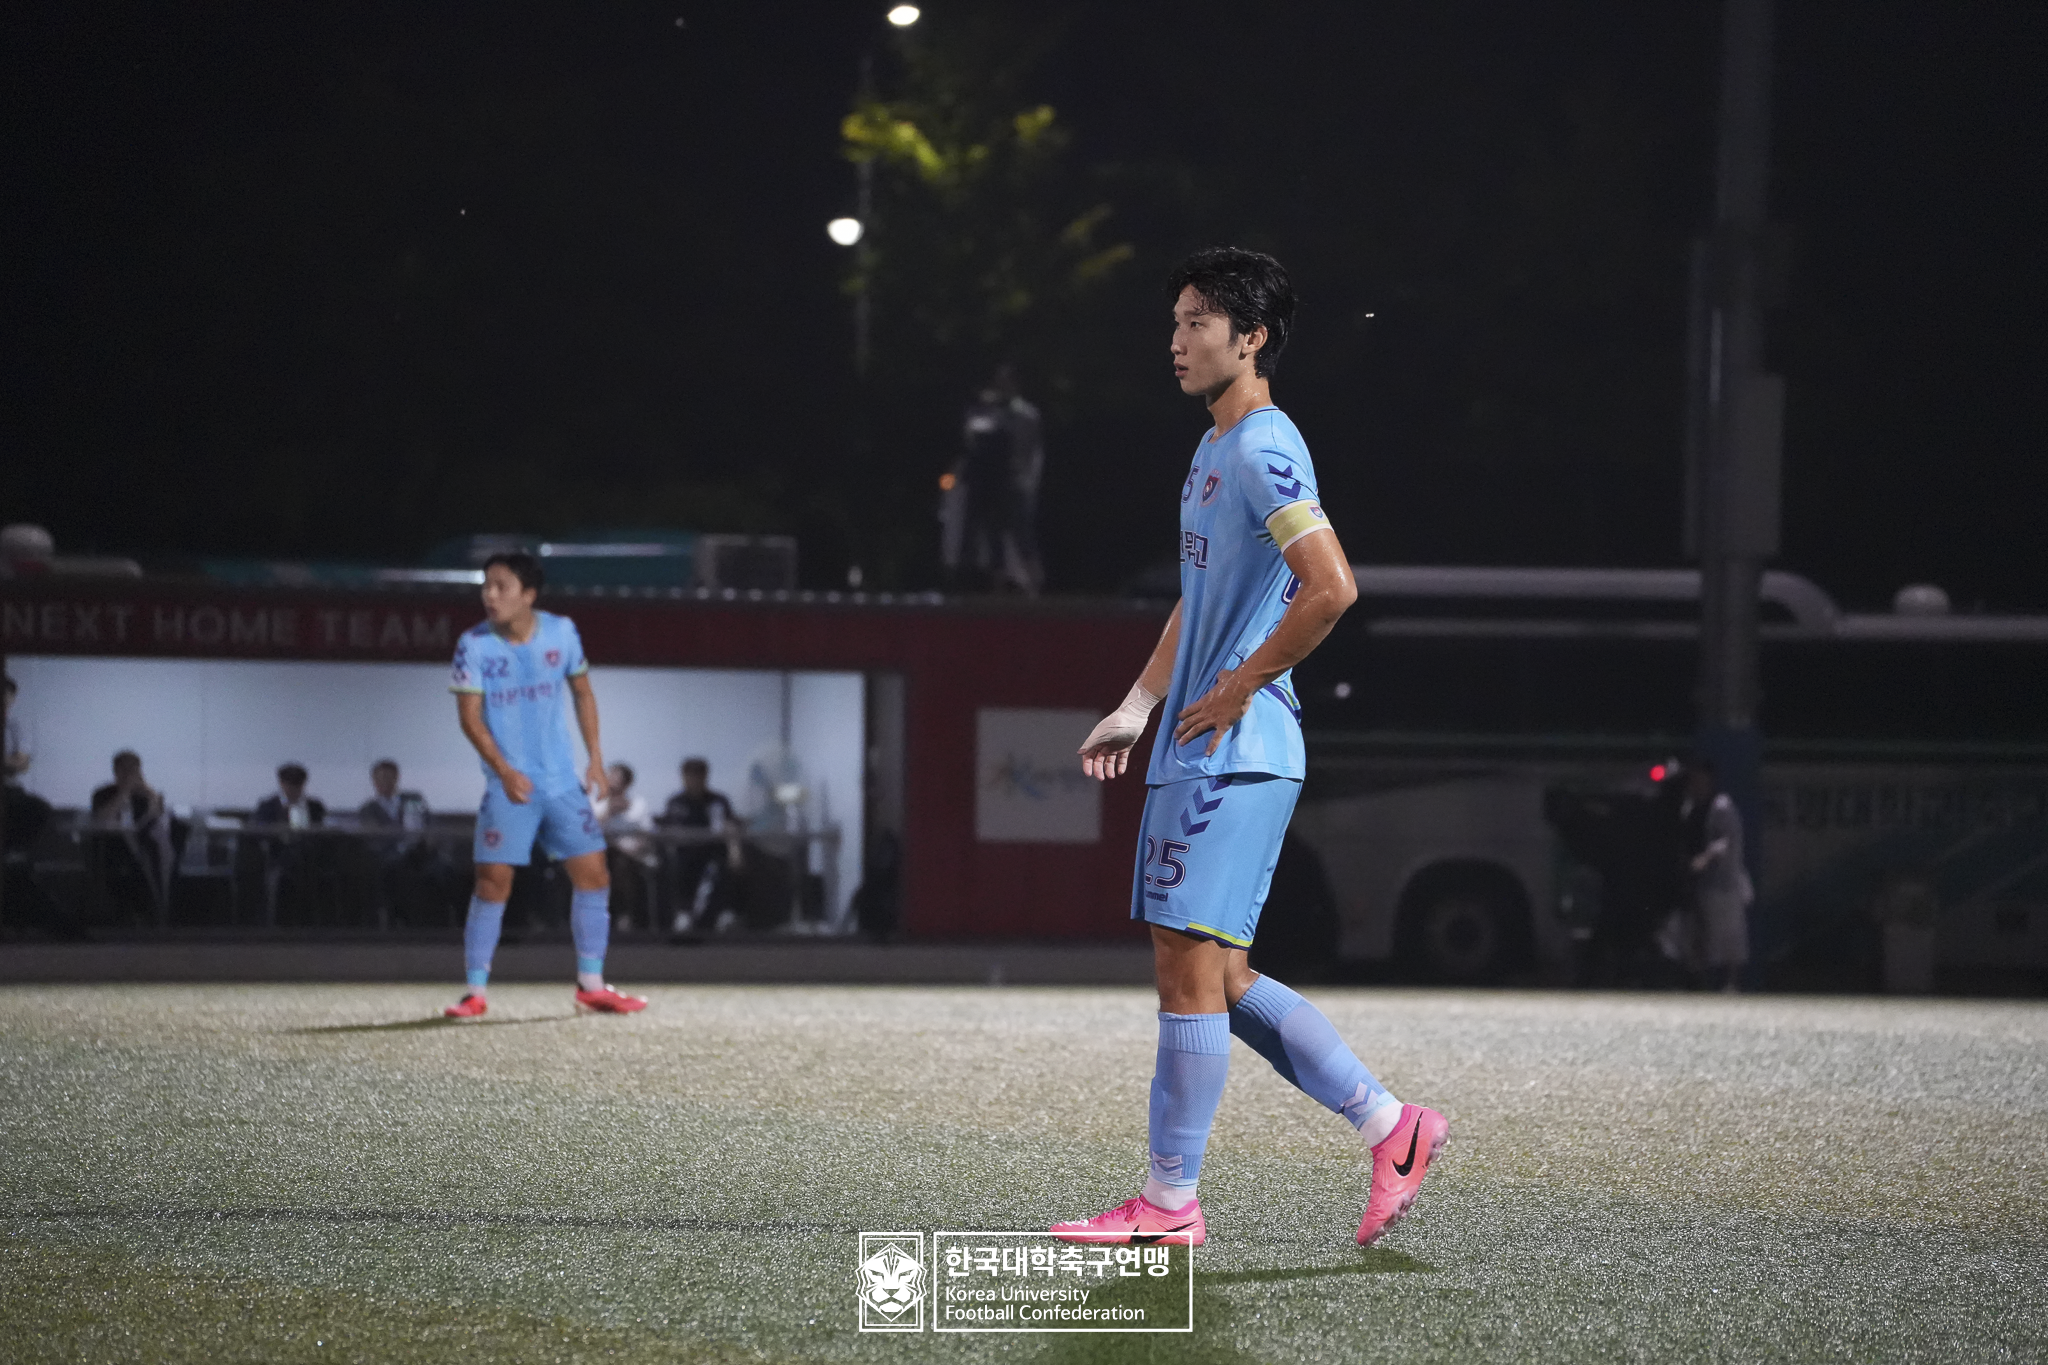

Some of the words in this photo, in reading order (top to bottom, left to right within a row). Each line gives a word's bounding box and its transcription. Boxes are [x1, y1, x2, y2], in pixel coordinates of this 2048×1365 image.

[2, 603, 135, 641] NEXT
[153, 607, 297, 645] HOME
[318, 609, 452, 648] TEAM
[482, 656, 509, 679] 22
